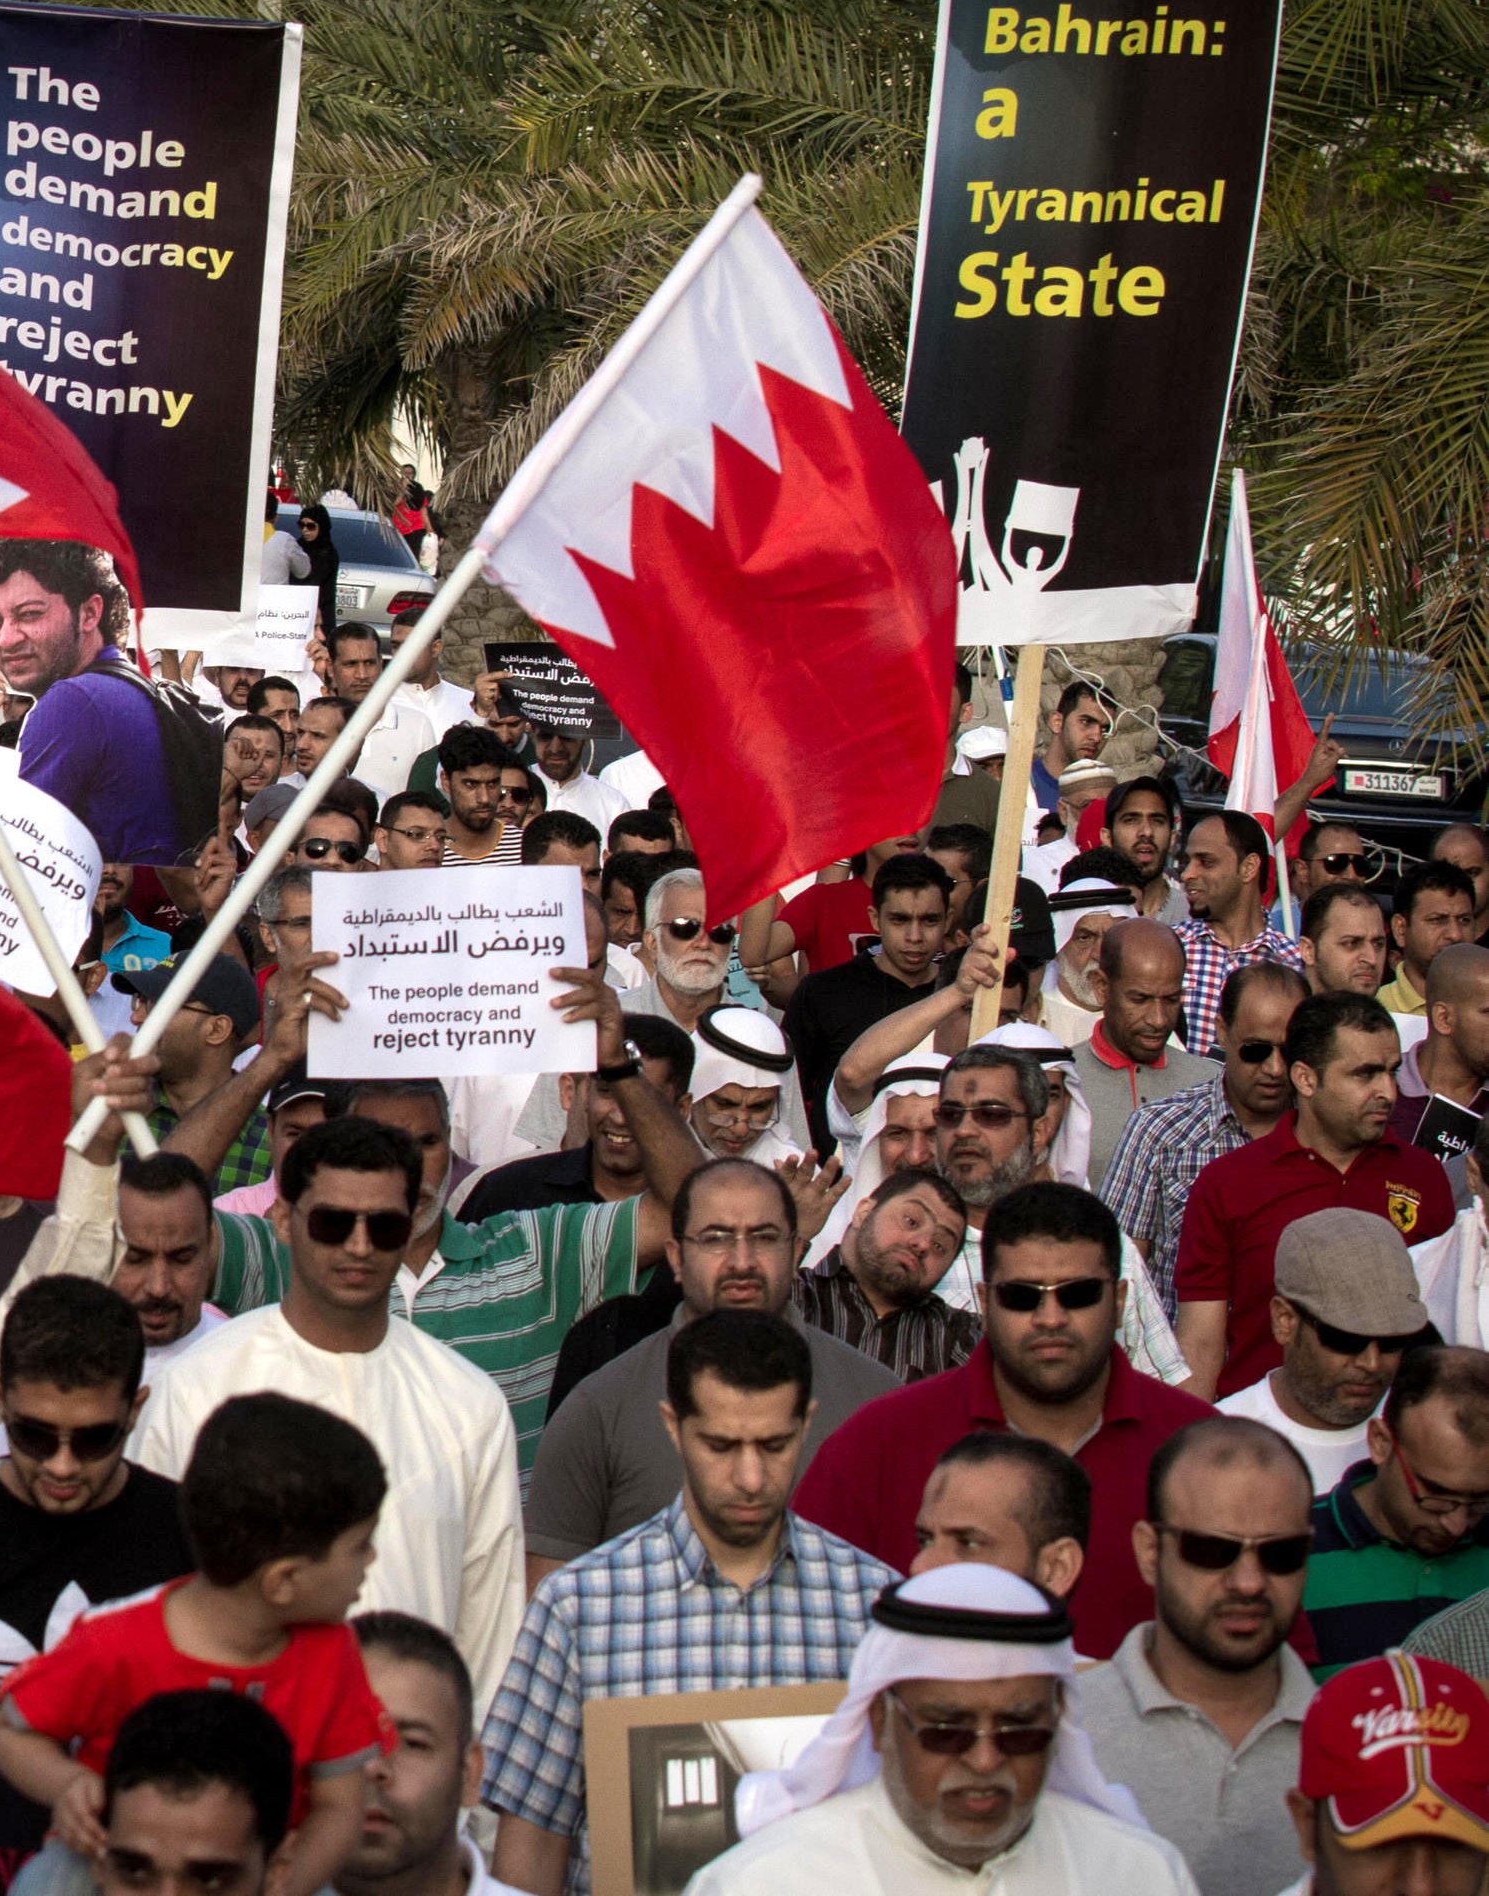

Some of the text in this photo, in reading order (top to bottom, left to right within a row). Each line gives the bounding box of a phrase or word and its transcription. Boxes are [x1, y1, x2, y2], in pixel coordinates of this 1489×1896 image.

[984, 4, 1226, 56] Bahrain:
[8, 66, 101, 112] The
[975, 87, 1018, 139] a
[7, 120, 185, 177] people
[4, 161, 217, 220] demand
[966, 177, 1225, 234] Tyrannical
[1, 216, 234, 280] democracy
[954, 251, 1165, 319] State
[513, 689, 595, 704] The people demand
[521, 701, 585, 716] democracy and
[548, 715, 593, 729] tyranny
[1365, 773, 1416, 792] 311367
[0, 813, 46, 845] يطالب
[15, 850, 86, 900] ويرفض
[48, 840, 94, 879] الشعب
[343, 901, 563, 929] الشعب يطالب بالديمقراطية
[343, 929, 565, 962] ويرفض الاستبداد
[368, 980, 539, 1003] The people demand
[387, 1005, 521, 1025] democracy and
[373, 1027, 536, 1053] reject tyranny
